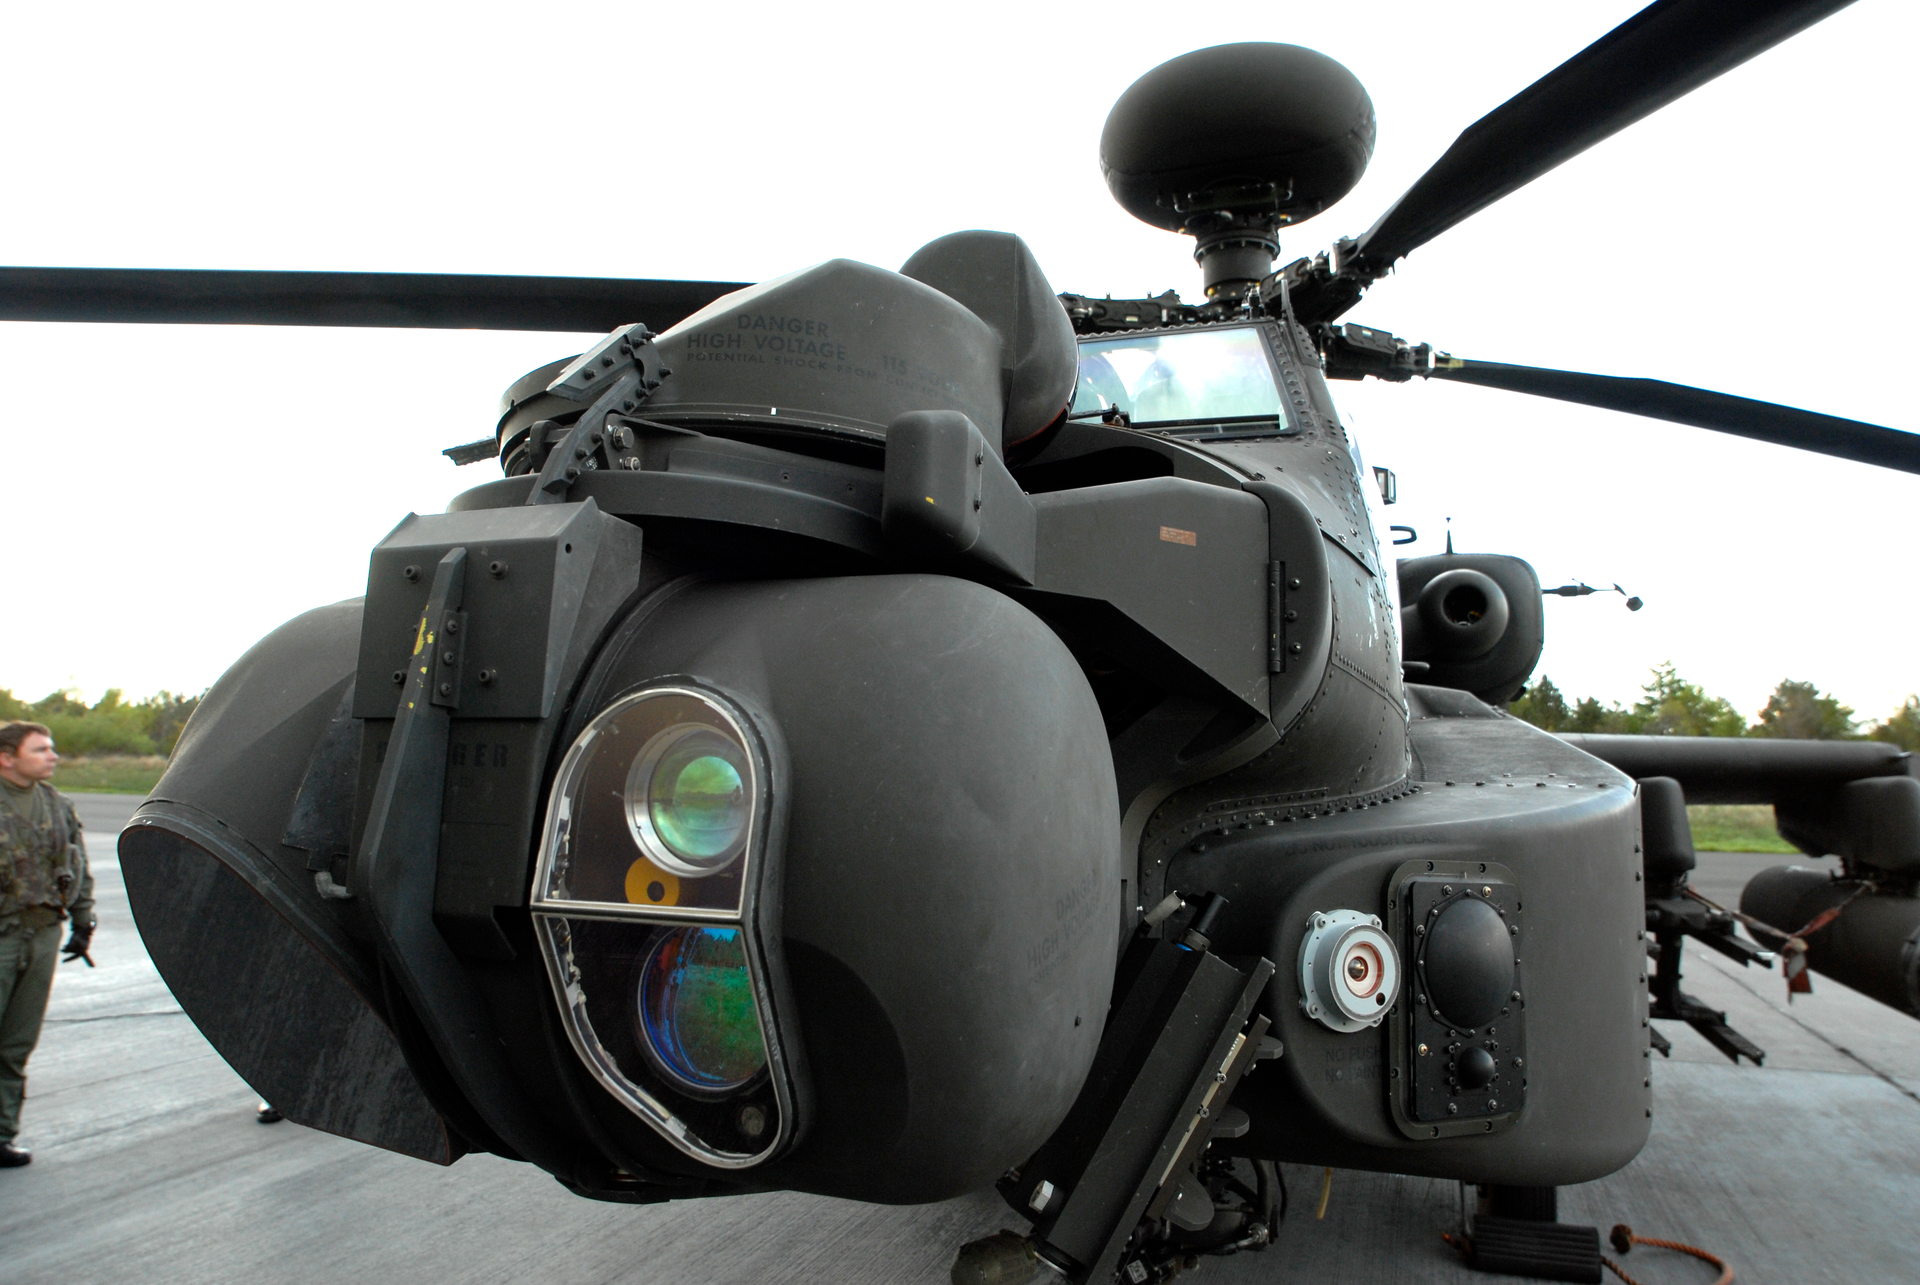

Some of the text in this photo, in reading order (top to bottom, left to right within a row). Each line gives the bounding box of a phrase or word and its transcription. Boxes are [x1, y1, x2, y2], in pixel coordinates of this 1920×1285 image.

[737, 313, 828, 338] DANGER
[687, 334, 742, 349] HIGH
[754, 334, 847, 361] VOLTAGE
[686, 352, 765, 363] POTENTIAL
[774, 355, 827, 371] SHOCK
[1026, 929, 1060, 968] HIGH
[1326, 1048, 1345, 1063] NO
[1325, 1068, 1344, 1083] NO
